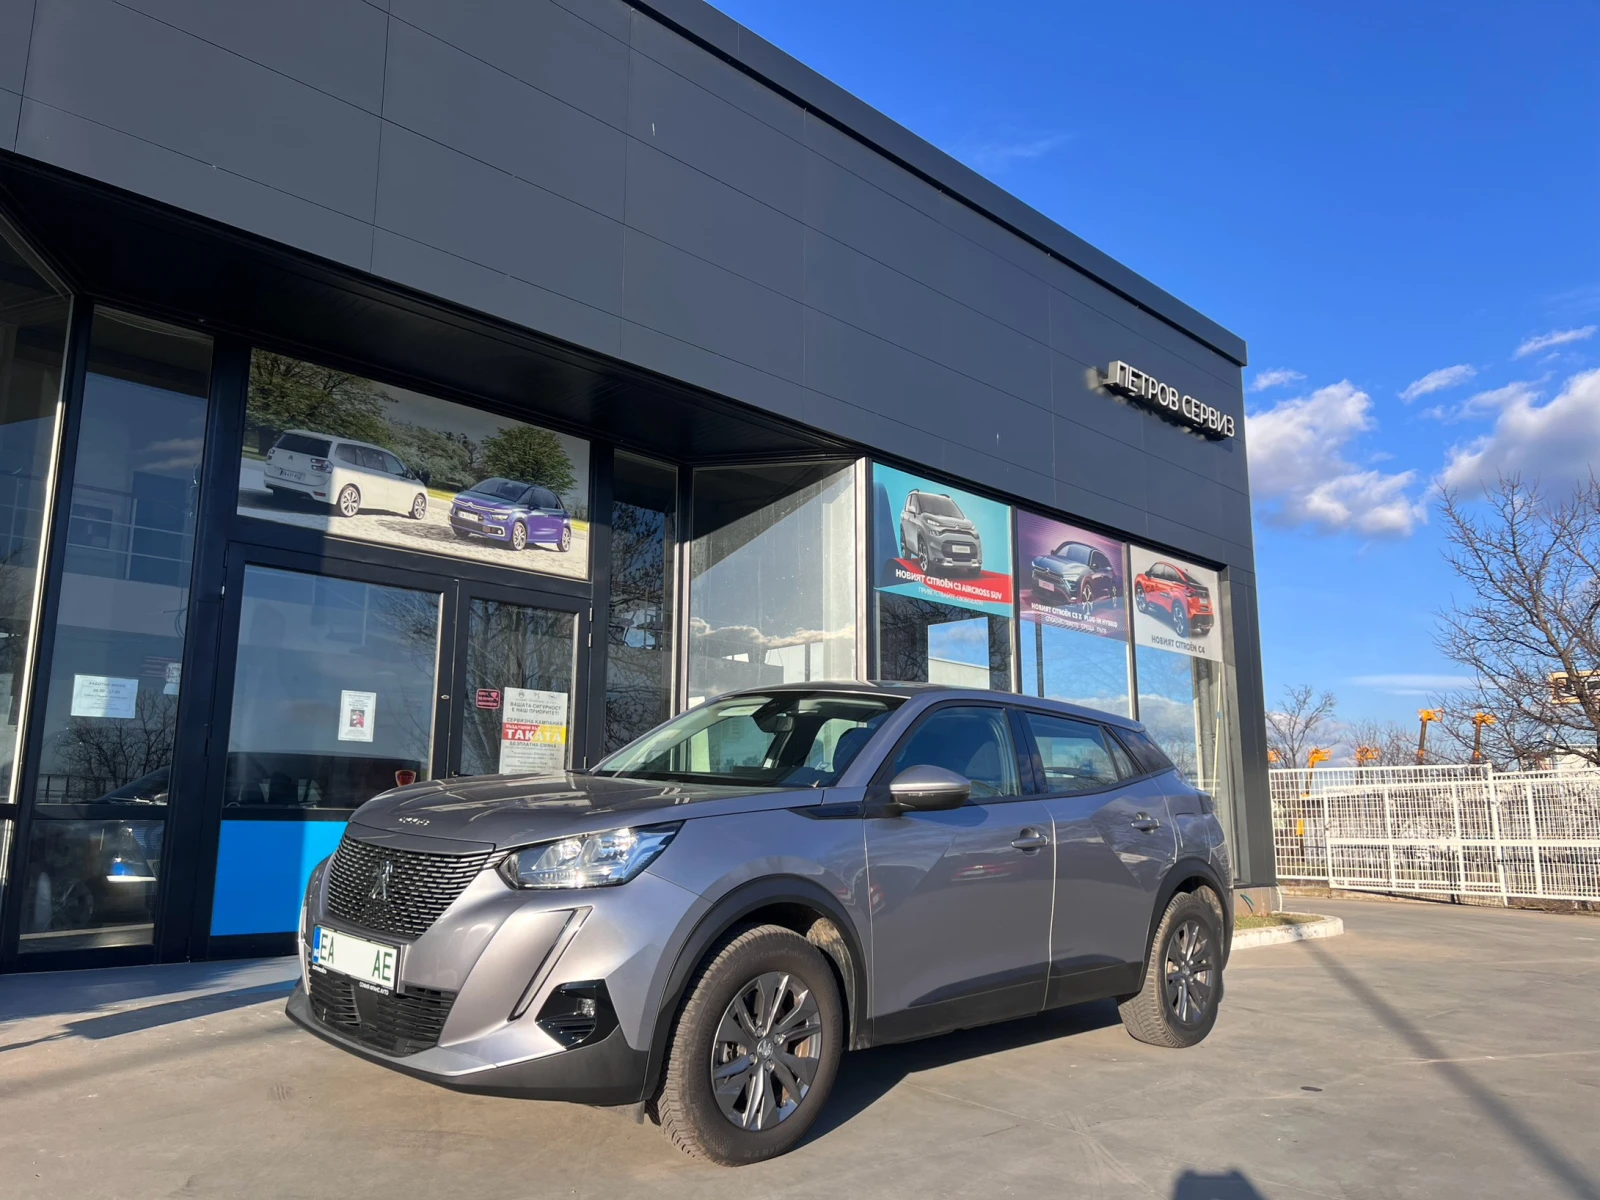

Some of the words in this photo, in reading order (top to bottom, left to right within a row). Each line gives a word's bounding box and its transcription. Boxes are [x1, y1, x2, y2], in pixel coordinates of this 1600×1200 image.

[1115, 360, 1179, 411] ПЕТРОВ
[1182, 395, 1235, 437] СЕРВИЗ
[895, 569, 925, 583] НОВИЯТ
[926, 575, 953, 589] CITROËN
[962, 584, 990, 598] AIRCROSS
[991, 590, 1002, 600] SUV
[1031, 602, 1051, 613] НОВИЯТ
[1151, 634, 1174, 647] НОВИЯТ
[1175, 640, 1197, 653] CITROËN
[1198, 645, 1205, 655] C4
[532, 703, 561, 711] СИГУРНОСТ
[319, 932, 335, 964] EA
[371, 949, 393, 982] AE
